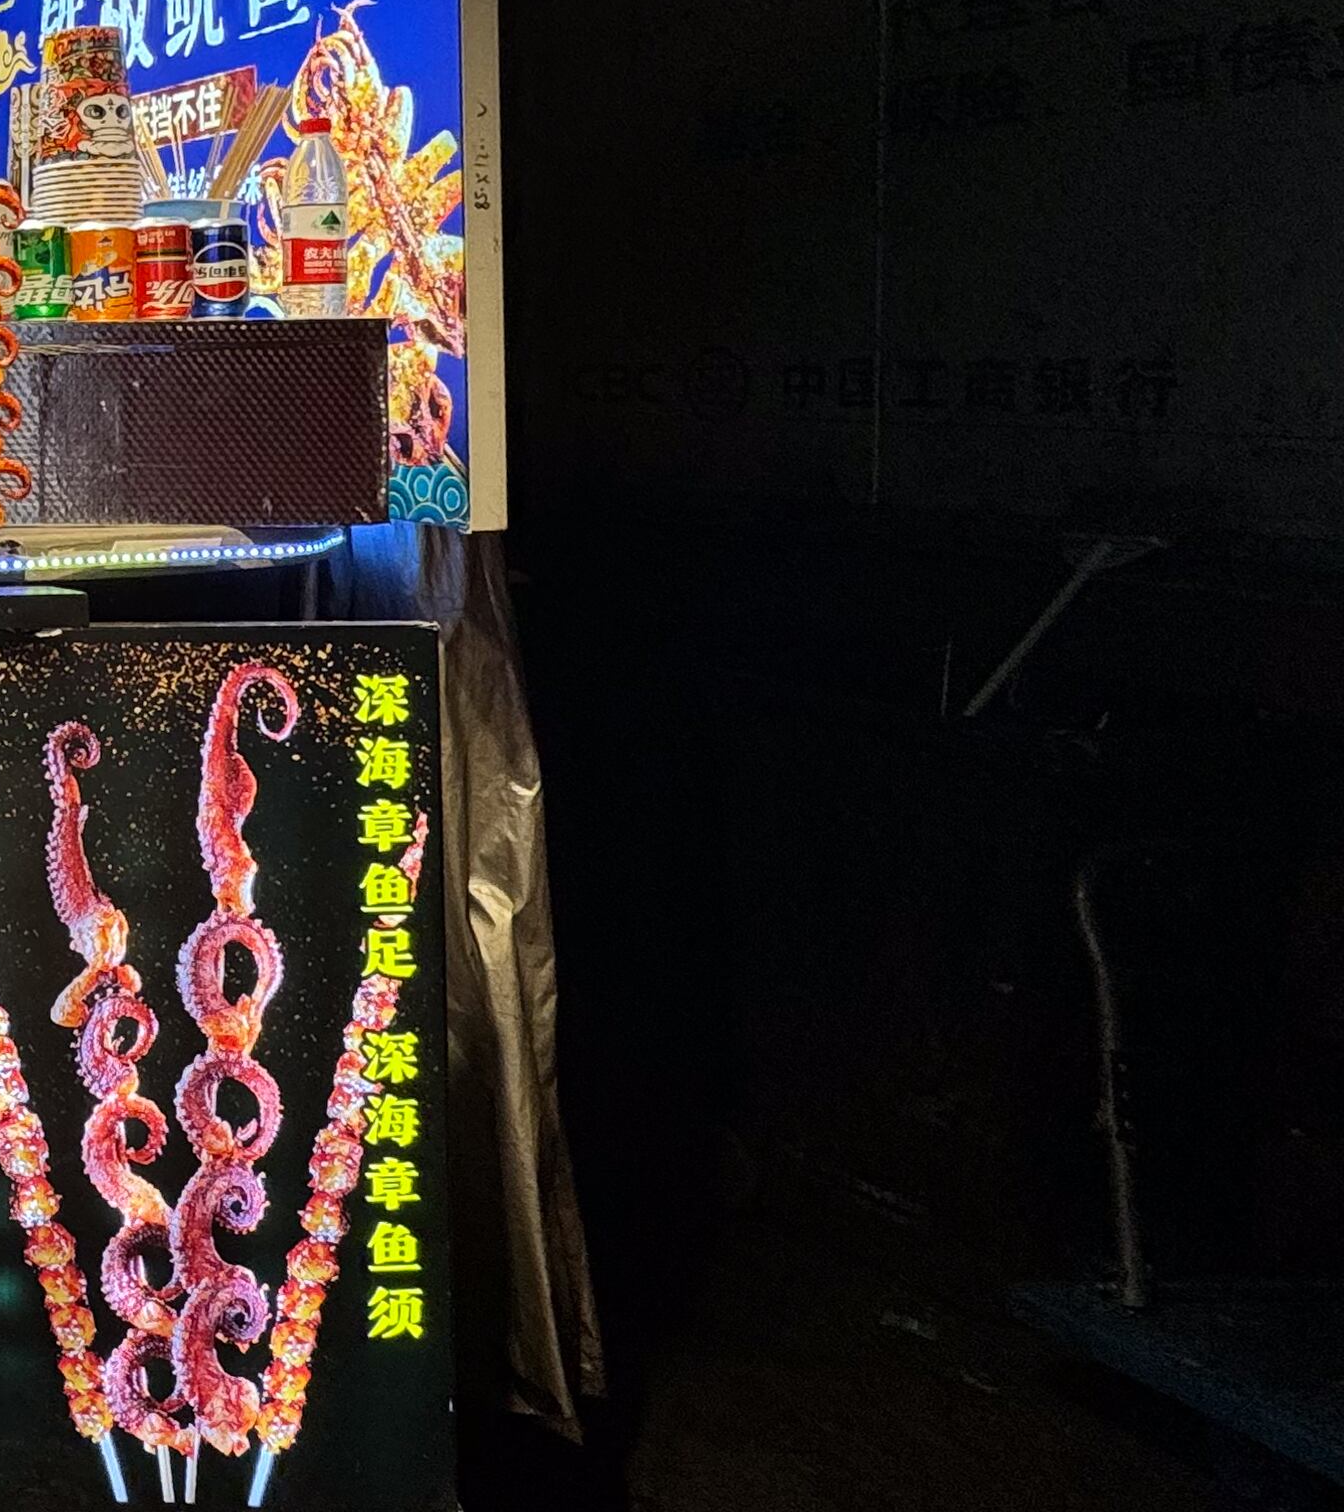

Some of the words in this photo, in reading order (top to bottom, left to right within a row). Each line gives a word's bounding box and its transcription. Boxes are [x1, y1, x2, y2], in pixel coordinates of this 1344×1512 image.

[354, 673, 418, 979] 深海章鱼足
[362, 1031, 425, 1340] 深海章鱼须
